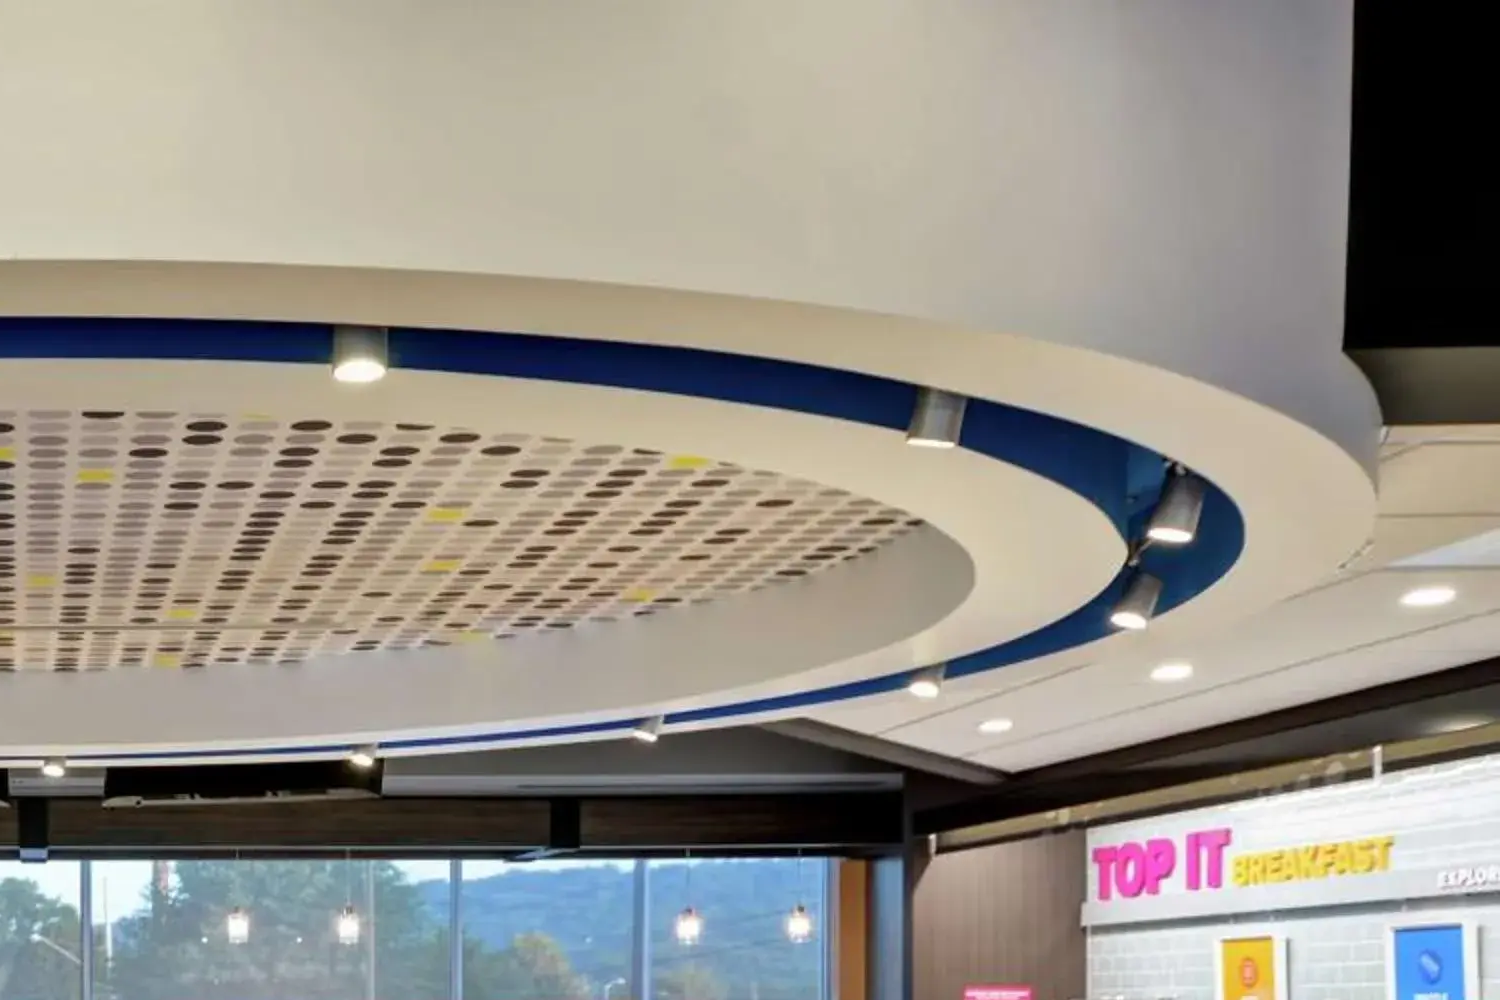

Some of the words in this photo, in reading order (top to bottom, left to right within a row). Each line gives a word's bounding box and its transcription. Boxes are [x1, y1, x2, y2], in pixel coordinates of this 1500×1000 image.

[1092, 838, 1176, 901] TOP
[1186, 828, 1232, 891] IT
[1232, 836, 1395, 887] BREAKFAST
